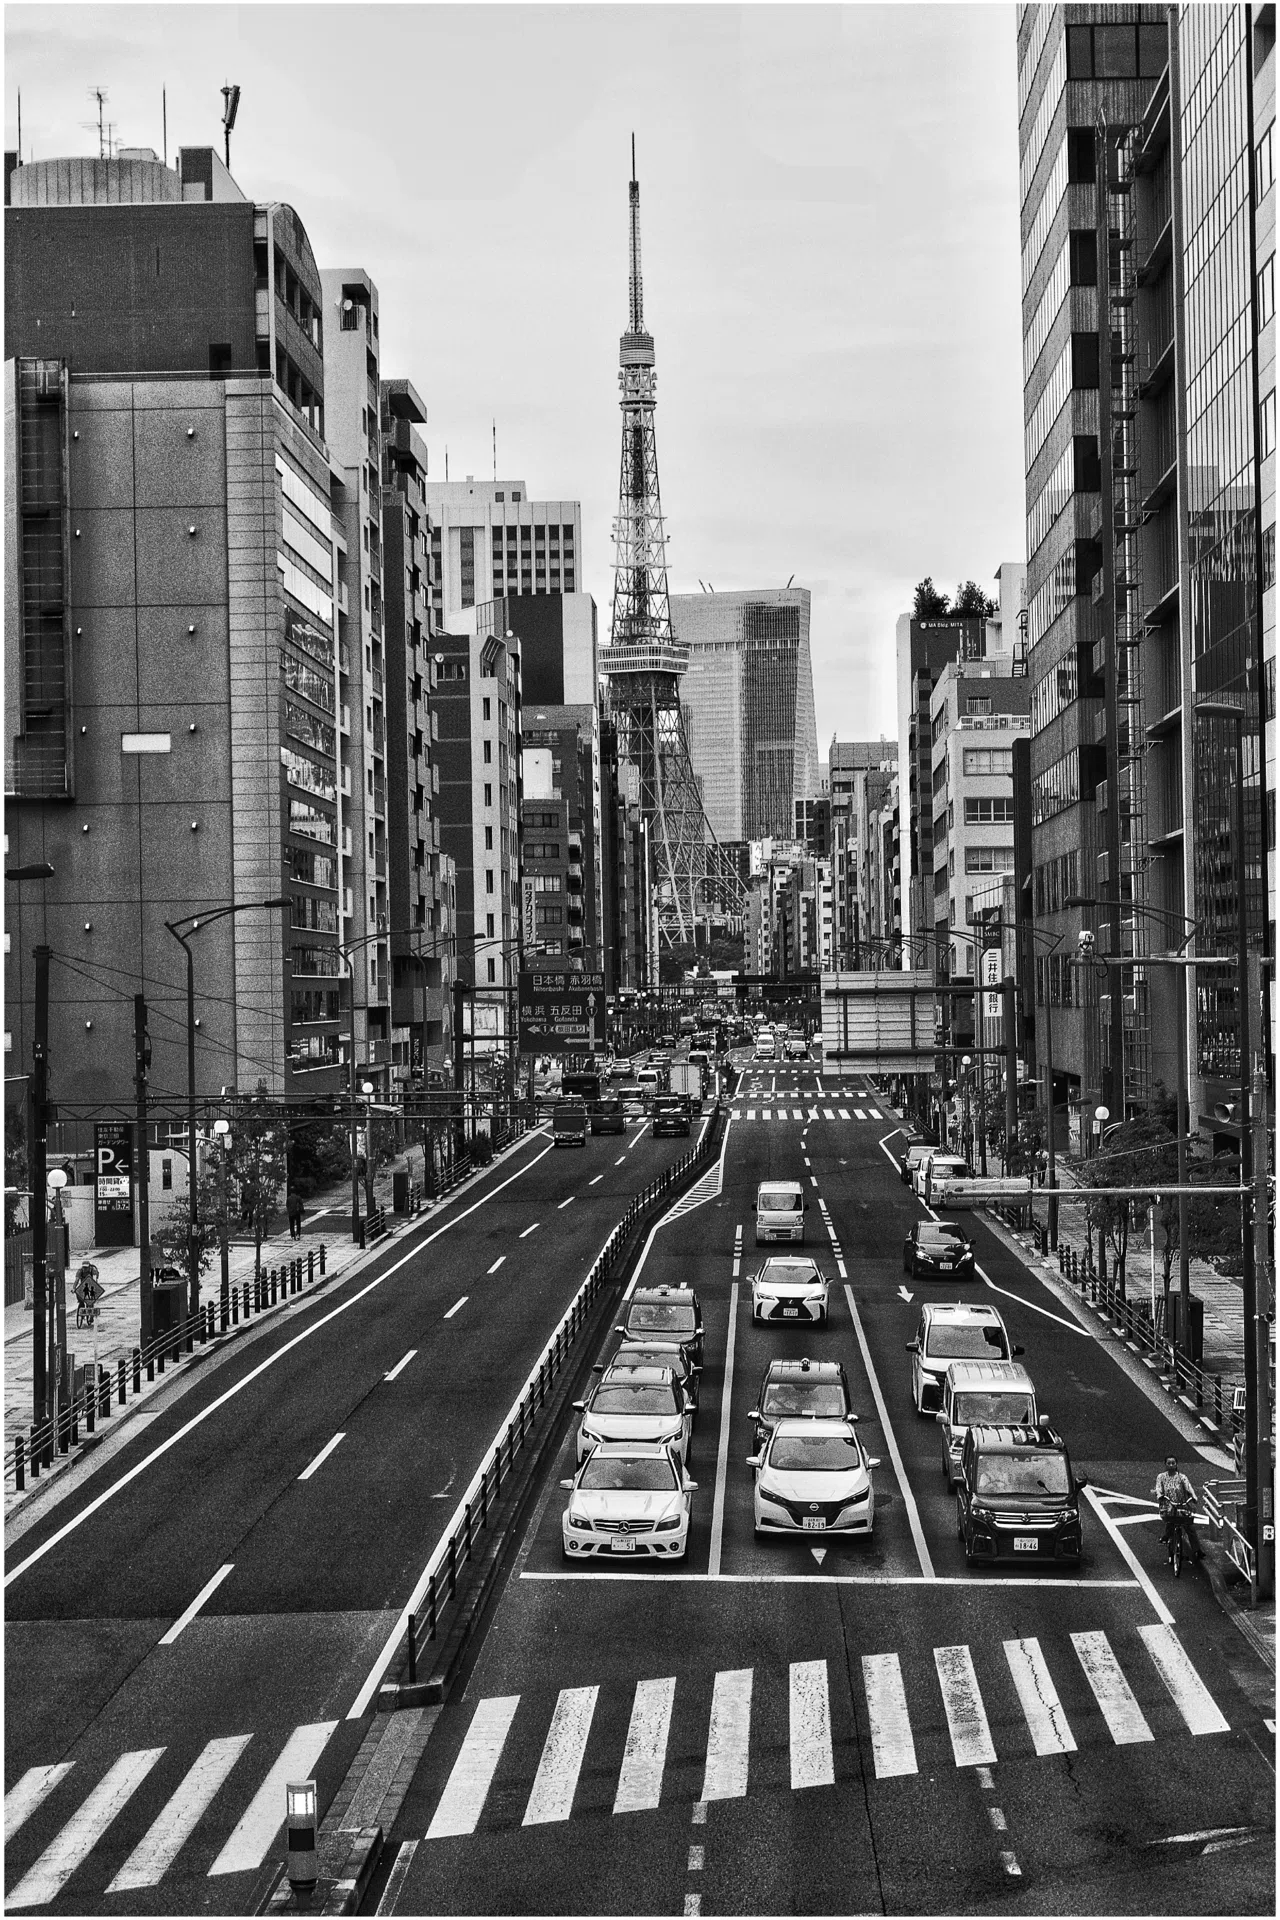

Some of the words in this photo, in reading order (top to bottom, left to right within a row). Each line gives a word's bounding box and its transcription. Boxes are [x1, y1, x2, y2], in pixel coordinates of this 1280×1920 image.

[532, 975, 564, 986] 日本橋
[570, 975, 602, 986] 赤羽橋
[987, 952, 998, 1013] 三井住銀行
[521, 1005, 545, 1016] 横浜
[550, 1005, 582, 1016] 五反田
[98, 1147, 115, 1174] P
